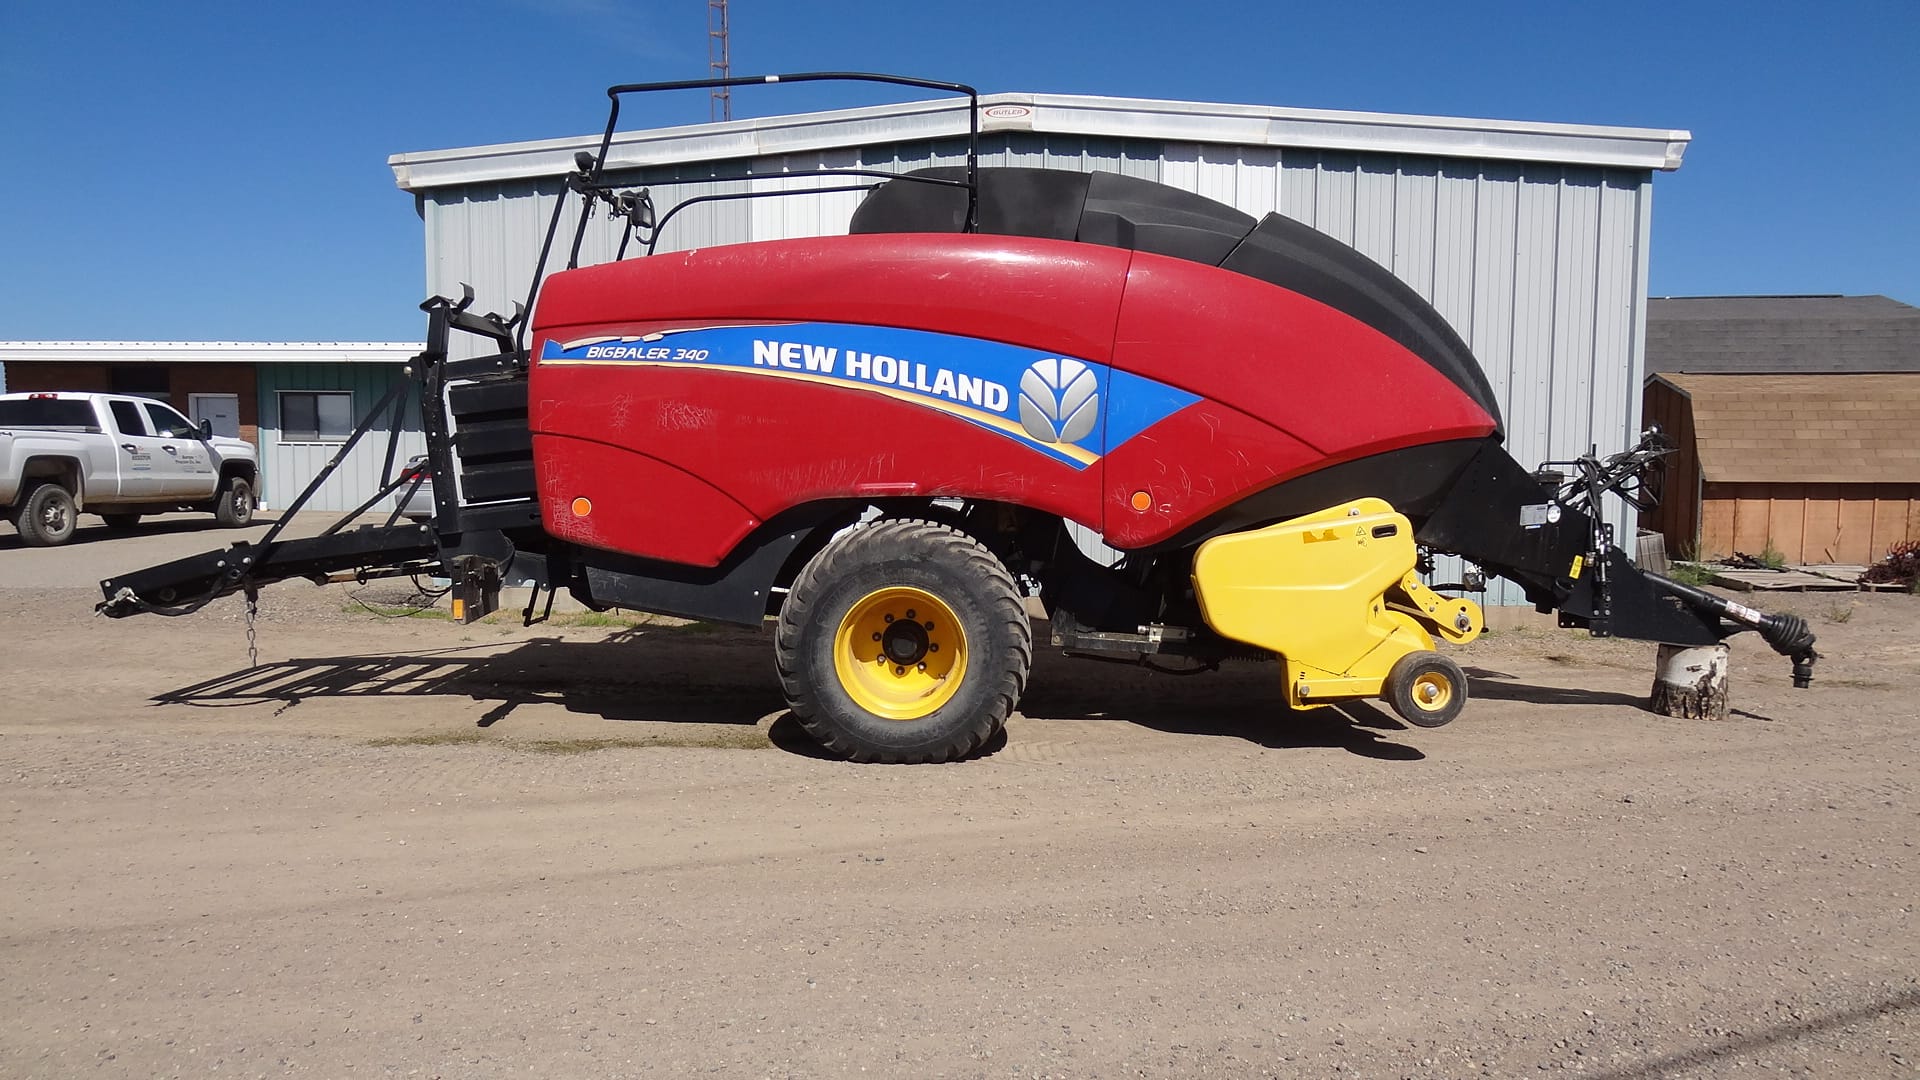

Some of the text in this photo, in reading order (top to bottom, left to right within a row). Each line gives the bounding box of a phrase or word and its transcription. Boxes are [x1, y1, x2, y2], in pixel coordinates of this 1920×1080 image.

[586, 346, 708, 361] BIGBALER 340
[753, 339, 1009, 412] NEW HOLLAND
